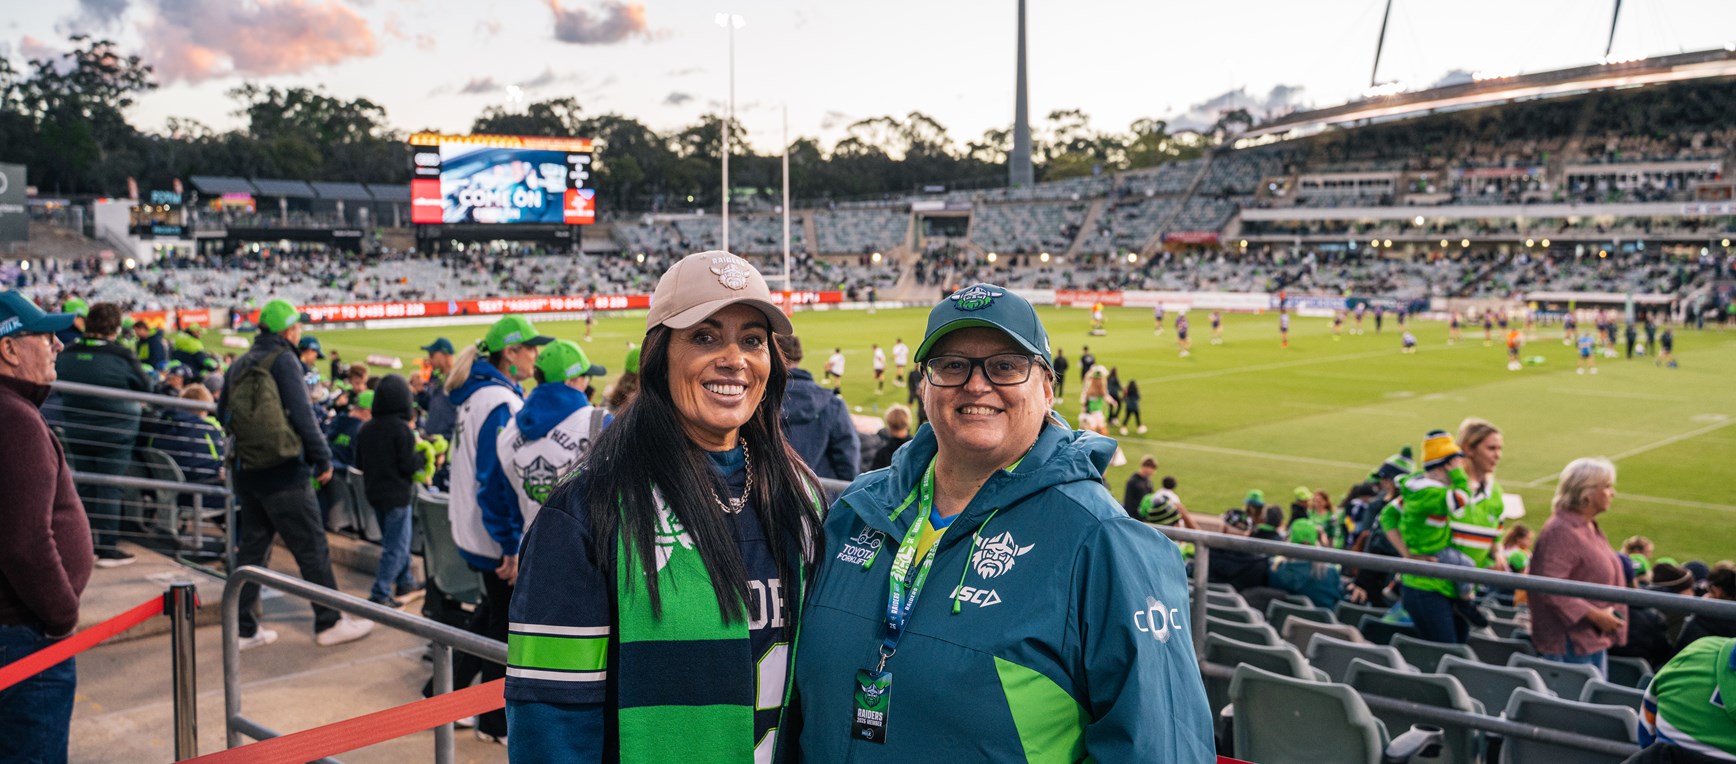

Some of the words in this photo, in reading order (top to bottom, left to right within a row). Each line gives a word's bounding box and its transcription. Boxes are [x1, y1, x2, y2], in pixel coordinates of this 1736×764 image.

[459, 189, 512, 207] COME
[512, 187, 542, 208] ON
[341, 305, 357, 319] TO
[478, 300, 503, 313] TEXT
[550, 298, 564, 310] TO
[551, 429, 577, 451] HELP
[842, 544, 875, 560] TOYOTA
[891, 592, 900, 615] RAIDERS
[905, 587, 918, 611] RAIDERS
[1134, 606, 1182, 632] CDC
[857, 708, 883, 721] RAIDERS
